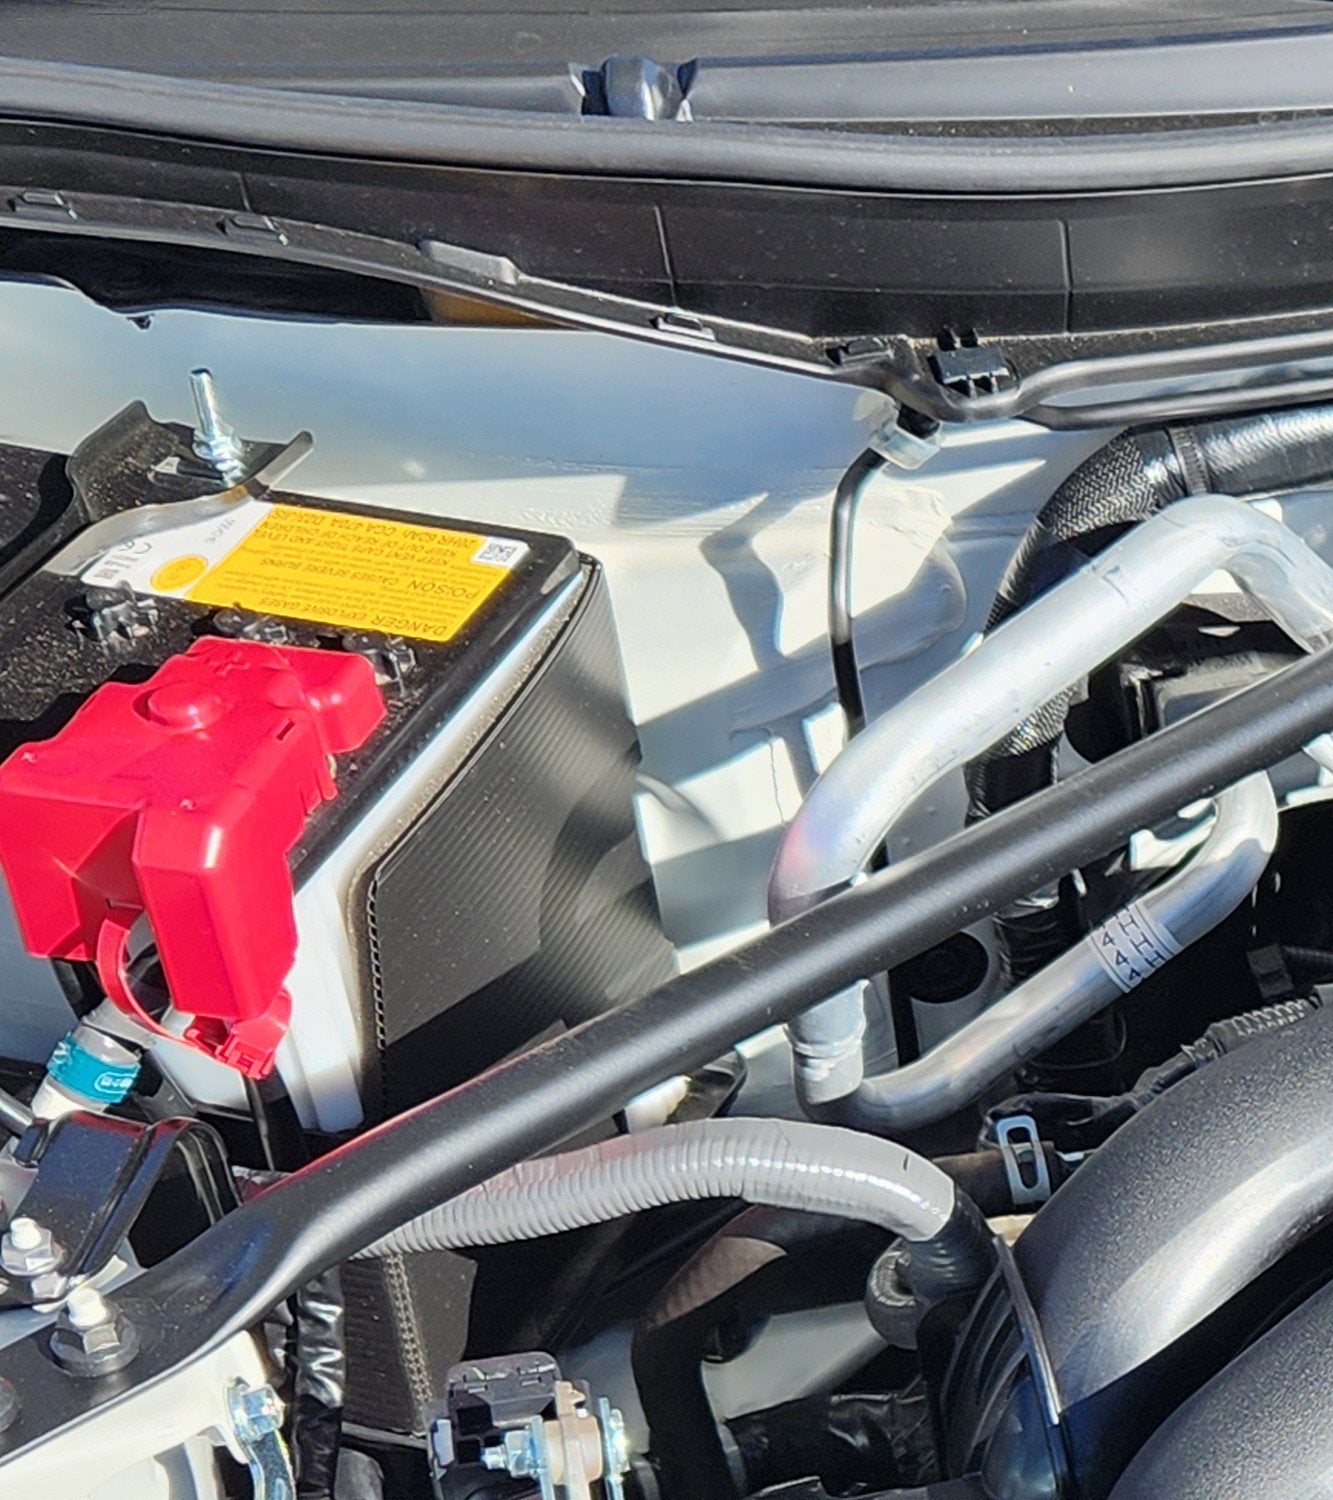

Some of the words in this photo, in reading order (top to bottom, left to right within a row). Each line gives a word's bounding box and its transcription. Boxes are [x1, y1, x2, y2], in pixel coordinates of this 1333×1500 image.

[364, 523, 396, 536] CCA
[406, 577, 481, 600] POISON
[370, 614, 447, 636] DANGER
